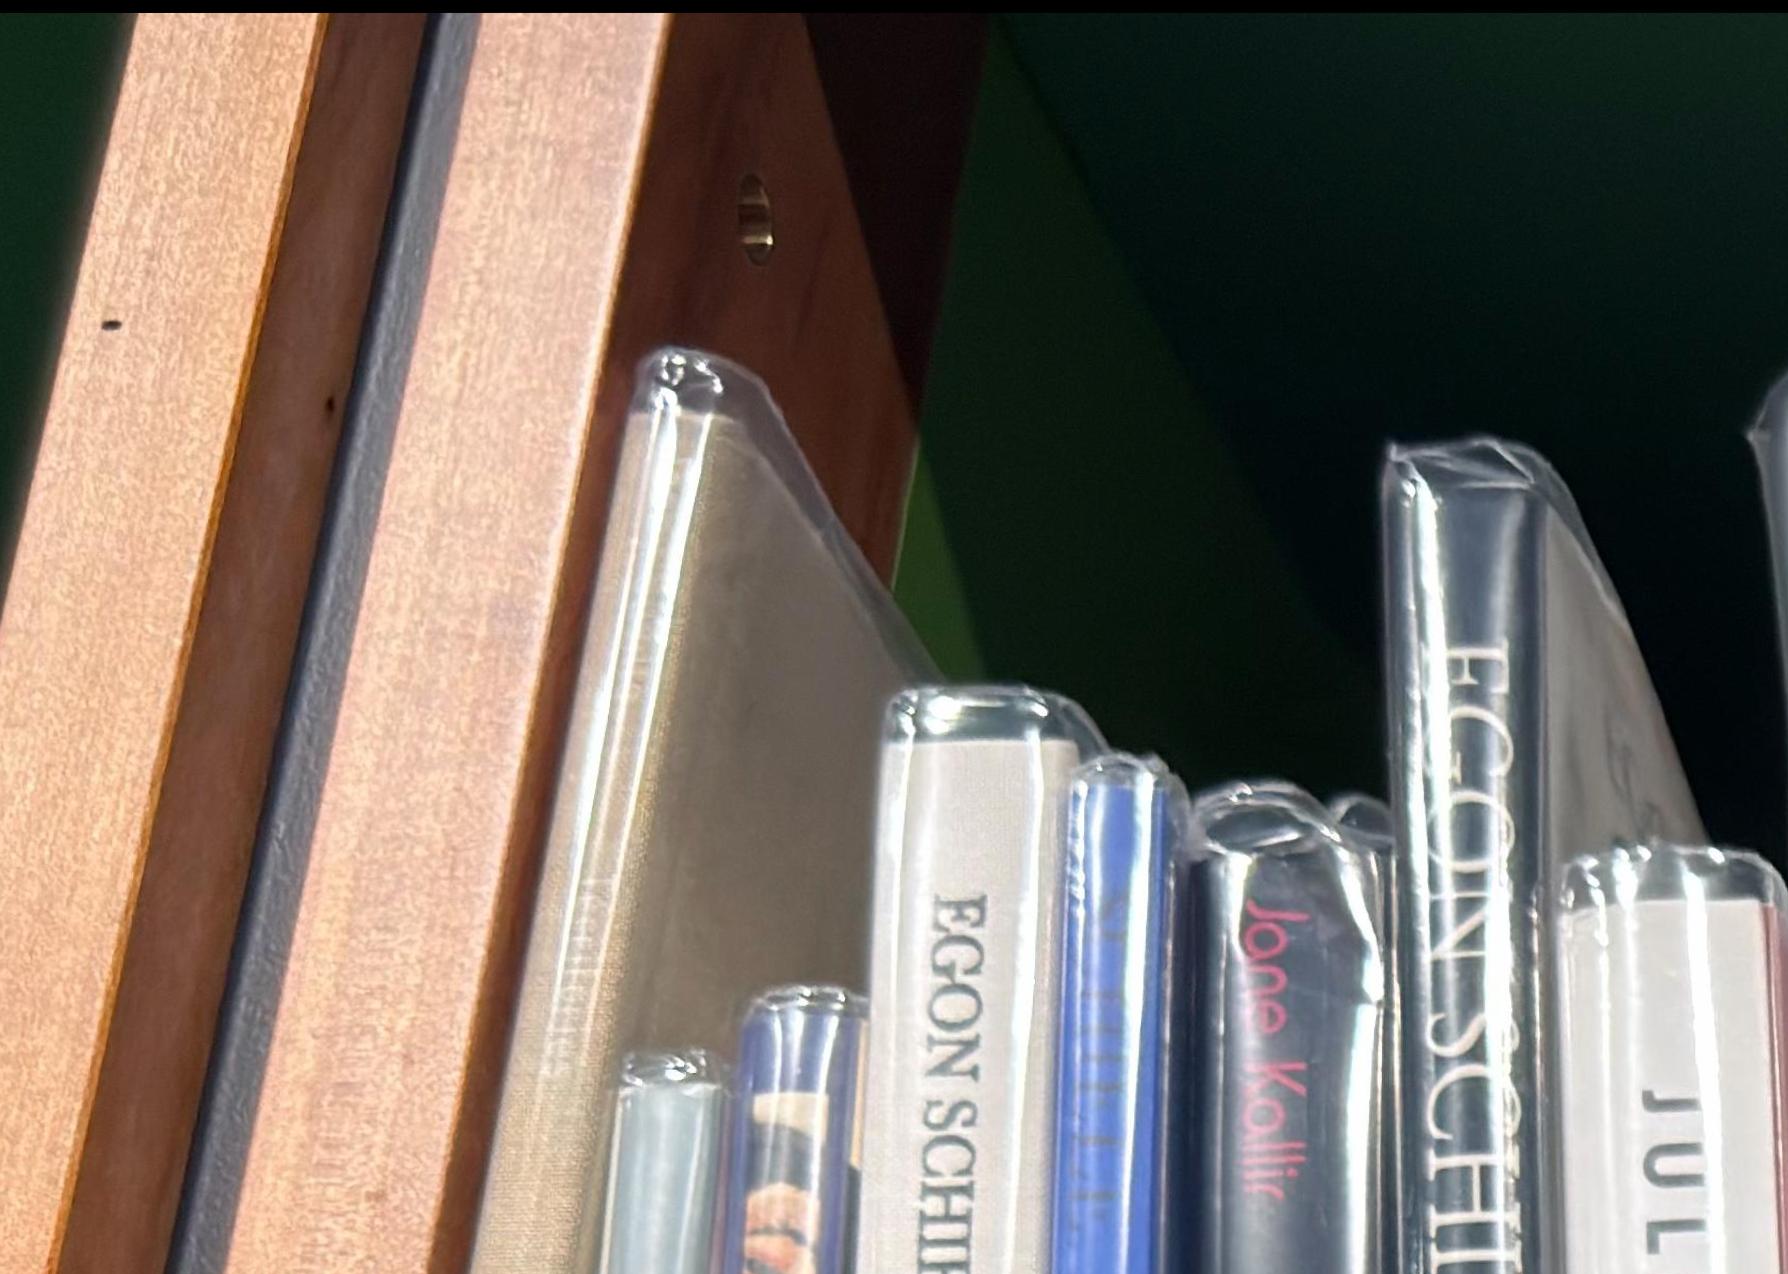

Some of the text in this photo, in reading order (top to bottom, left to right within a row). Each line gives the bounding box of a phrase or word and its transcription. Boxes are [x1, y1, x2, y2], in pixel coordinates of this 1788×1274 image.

[1423, 642, 1516, 961] EGON
[925, 894, 988, 1080] EGON
[1244, 904, 1309, 1033] Jane
